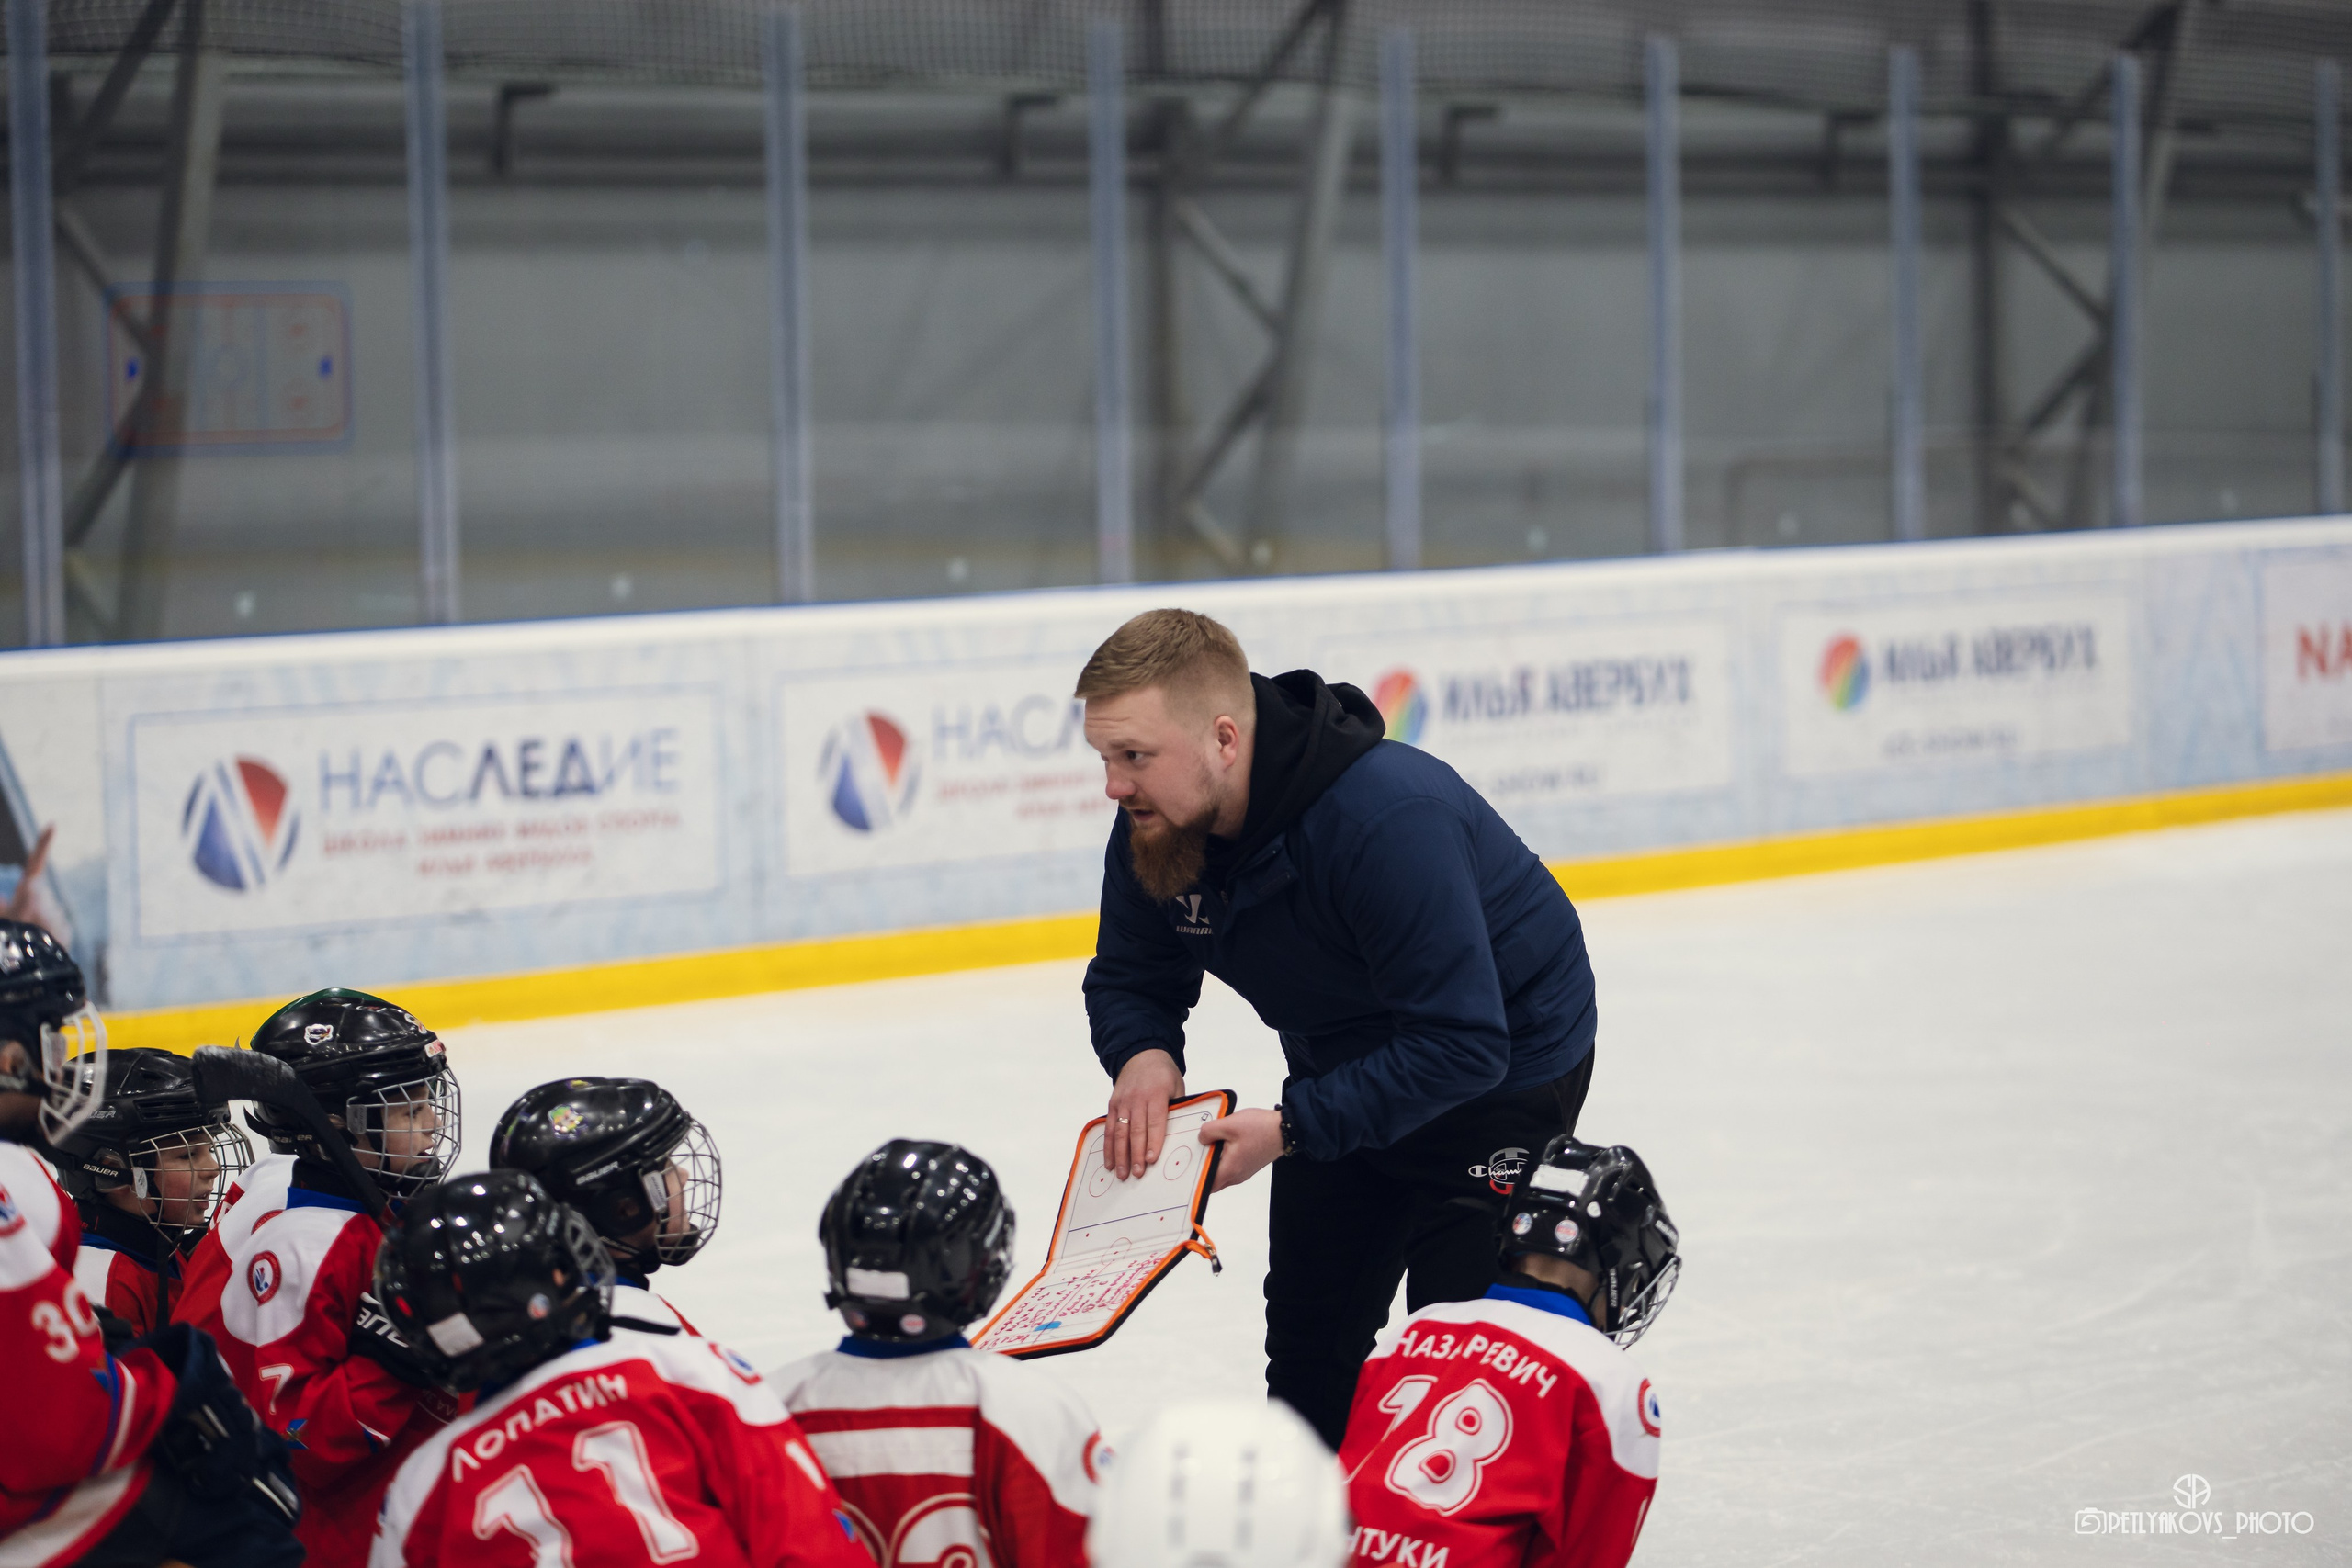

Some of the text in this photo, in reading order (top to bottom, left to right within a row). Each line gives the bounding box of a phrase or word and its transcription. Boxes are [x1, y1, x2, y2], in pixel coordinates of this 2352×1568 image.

[320, 728, 680, 813] НАСЛЕДИЕ
[83, 1163, 119, 1178] BAUER
[576, 1160, 619, 1186] BAUER
[29, 1279, 103, 1364] 30
[451, 1372, 628, 1483] ЛОПАТИН
[1369, 1374, 1514, 1517] 18
[472, 1419, 700, 1568] 11
